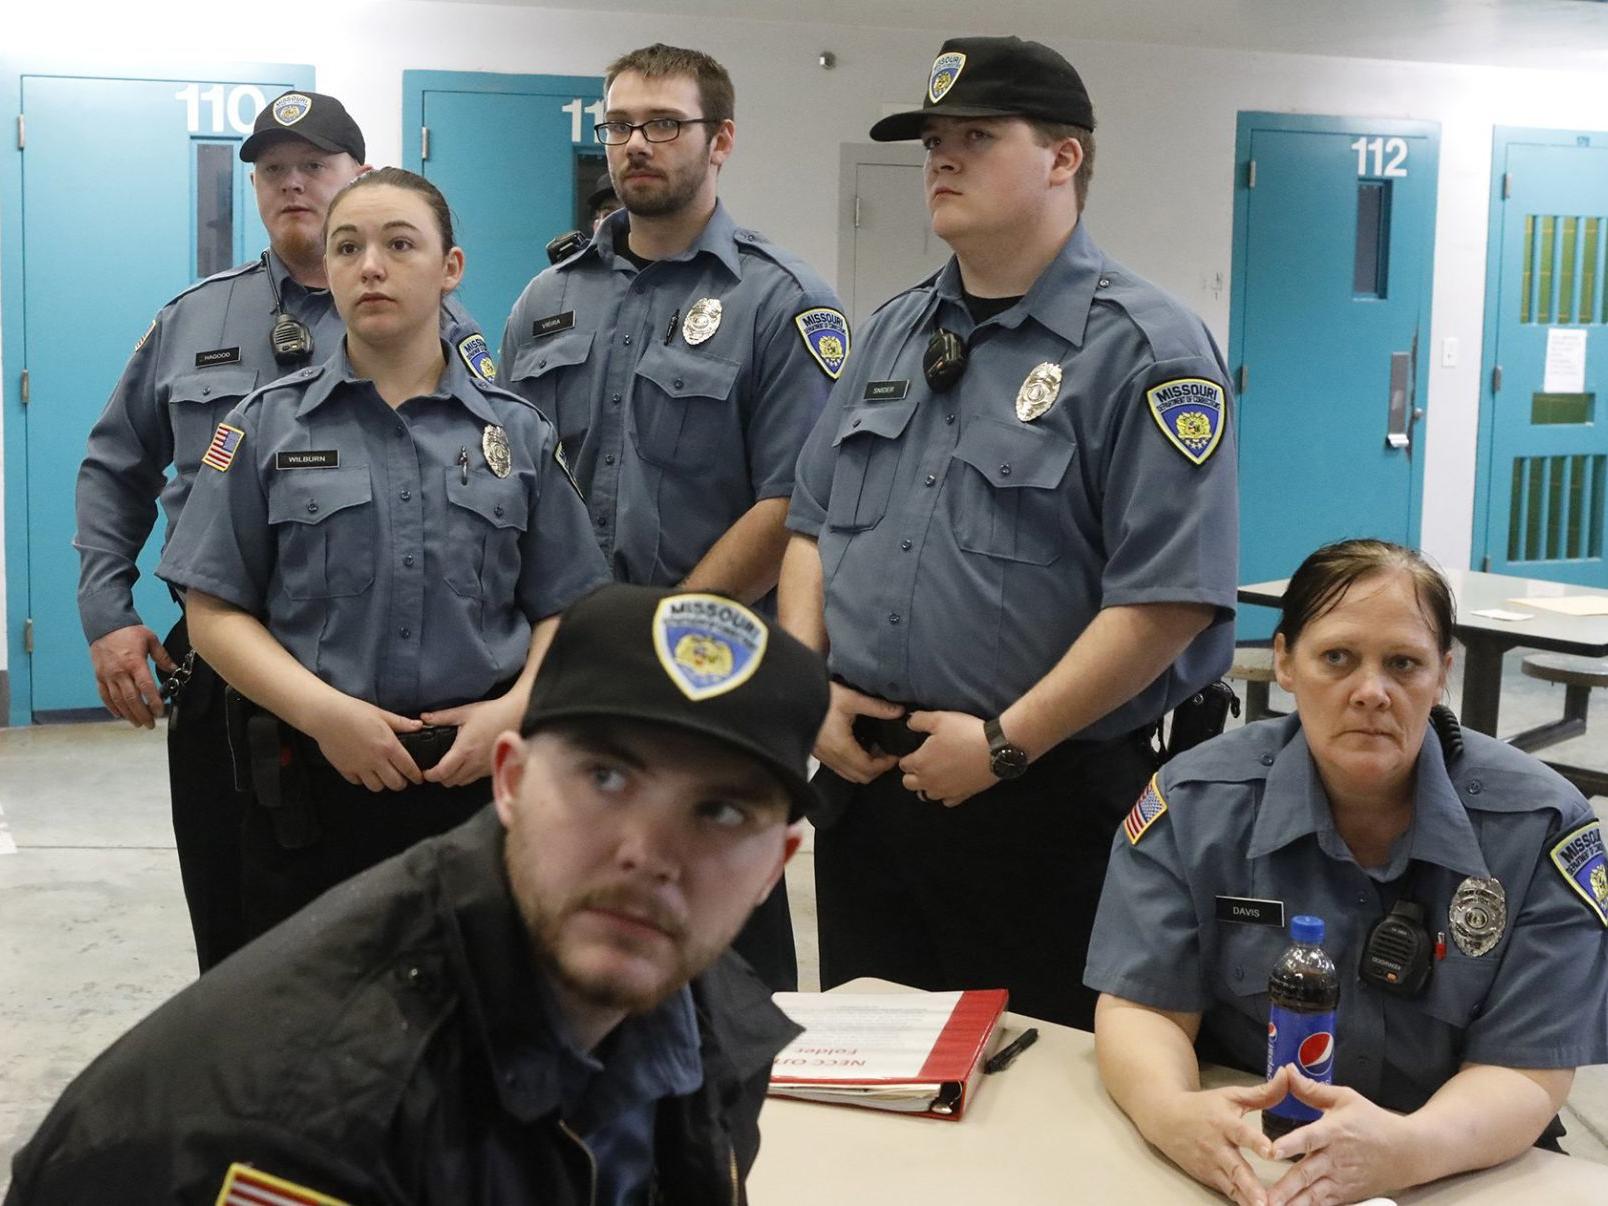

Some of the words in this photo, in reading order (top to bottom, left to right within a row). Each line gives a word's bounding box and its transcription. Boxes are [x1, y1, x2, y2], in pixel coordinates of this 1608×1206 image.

[175, 84, 266, 134] 110
[562, 98, 605, 144] 11
[1351, 137, 1408, 177] 112
[802, 312, 844, 327] MISSOURI
[1156, 384, 1218, 403] MISSOURI
[288, 455, 326, 463] WILBURN
[670, 602, 761, 638] MISSOURI
[1560, 828, 1601, 863] MISSO
[1233, 906, 1260, 918] DAVIS
[814, 1059, 866, 1067] NECC
